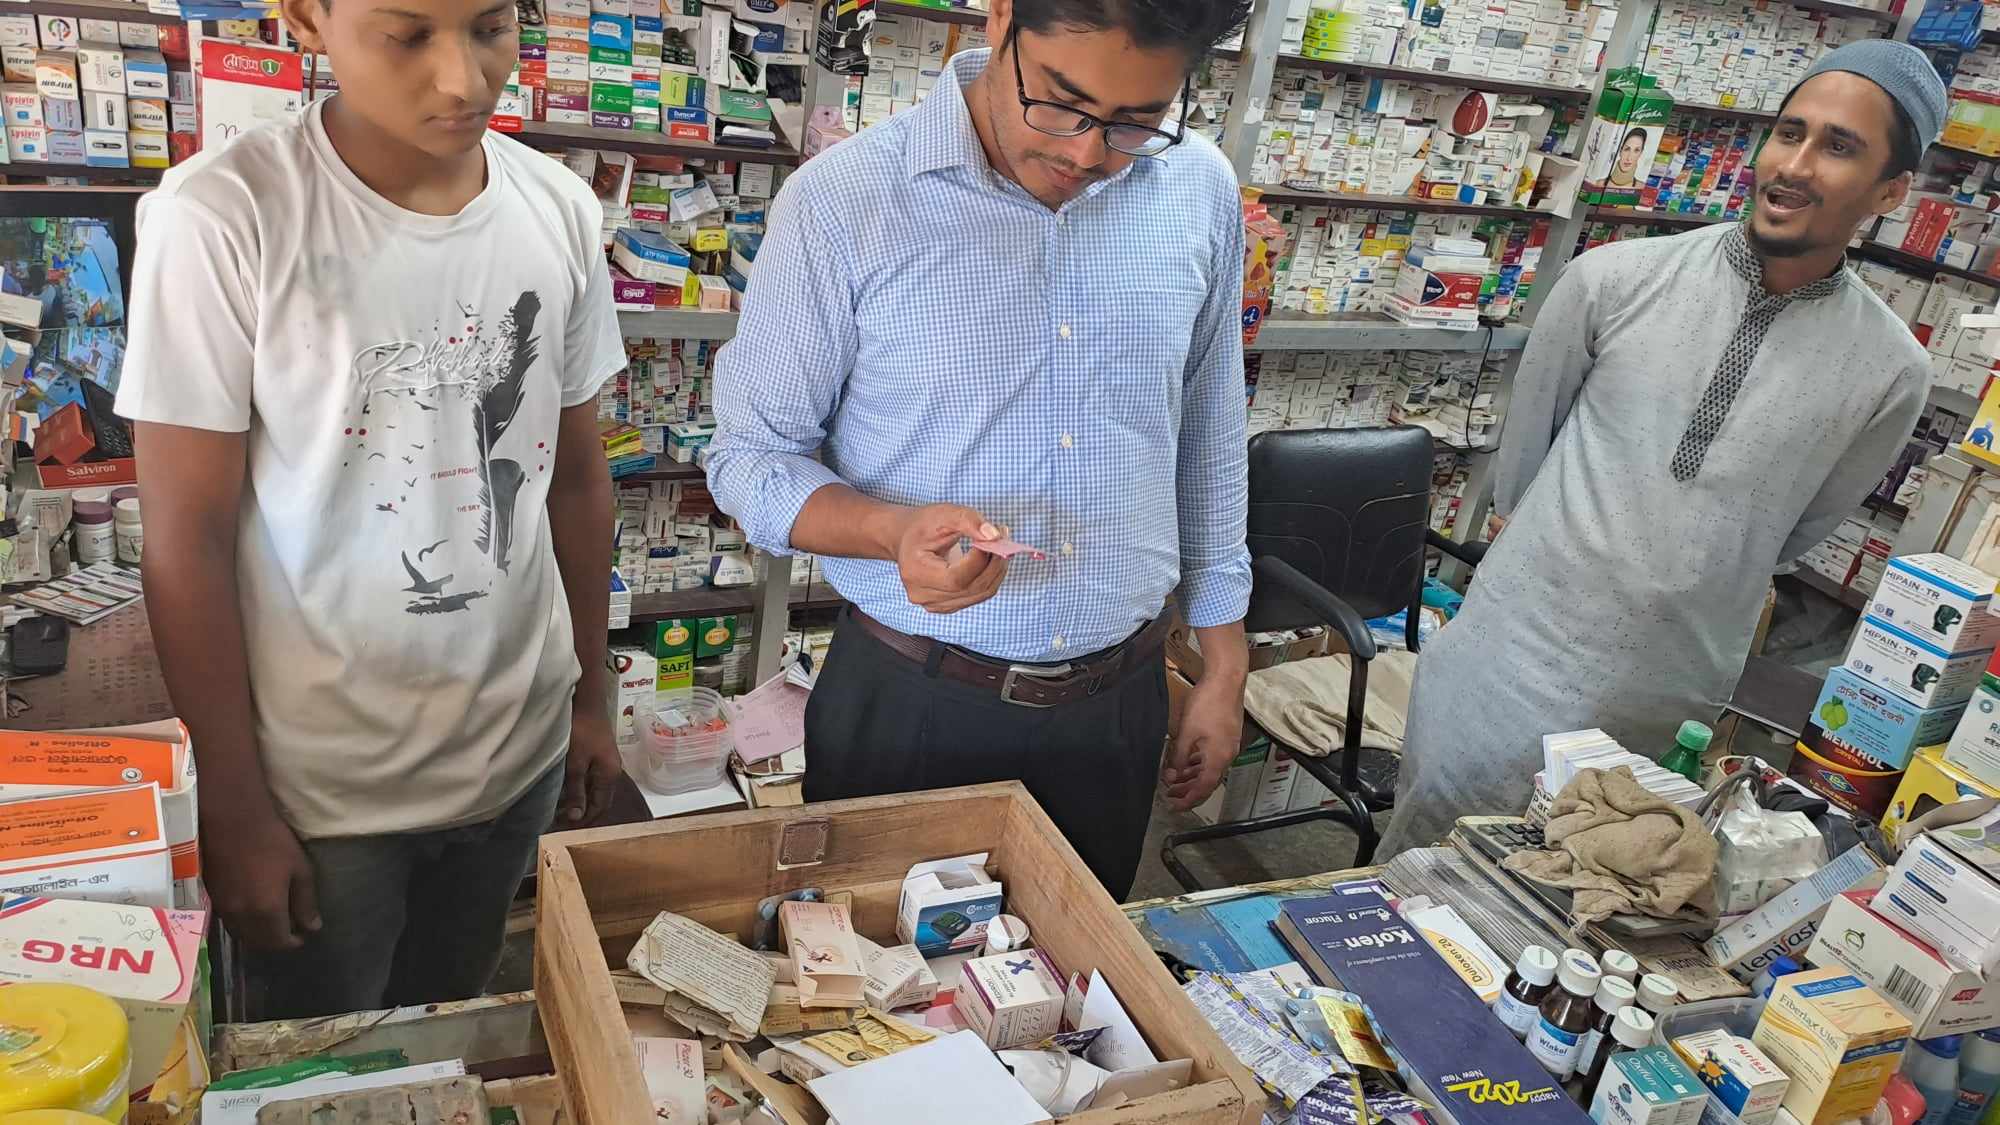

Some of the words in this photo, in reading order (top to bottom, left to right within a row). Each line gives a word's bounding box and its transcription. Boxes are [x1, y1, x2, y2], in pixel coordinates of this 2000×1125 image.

[66, 464, 116, 476] Salviron
[660, 661, 690, 673] SAFI
[1821, 730, 1885, 770] MENTHOL
[1304, 914, 1343, 925] Flucon
[1343, 929, 1415, 948] Kofen
[1438, 938, 1452, 949] 20
[22, 939, 154, 974] NRG
[1449, 946, 1483, 984] Duloxen
[1779, 993, 1819, 1031] Fiberlax
[1819, 1028, 1839, 1050] Ultra
[1461, 1069, 1484, 1080] New
[1468, 1080, 1529, 1105] 2022
[1530, 1091, 1560, 1105] Happy
